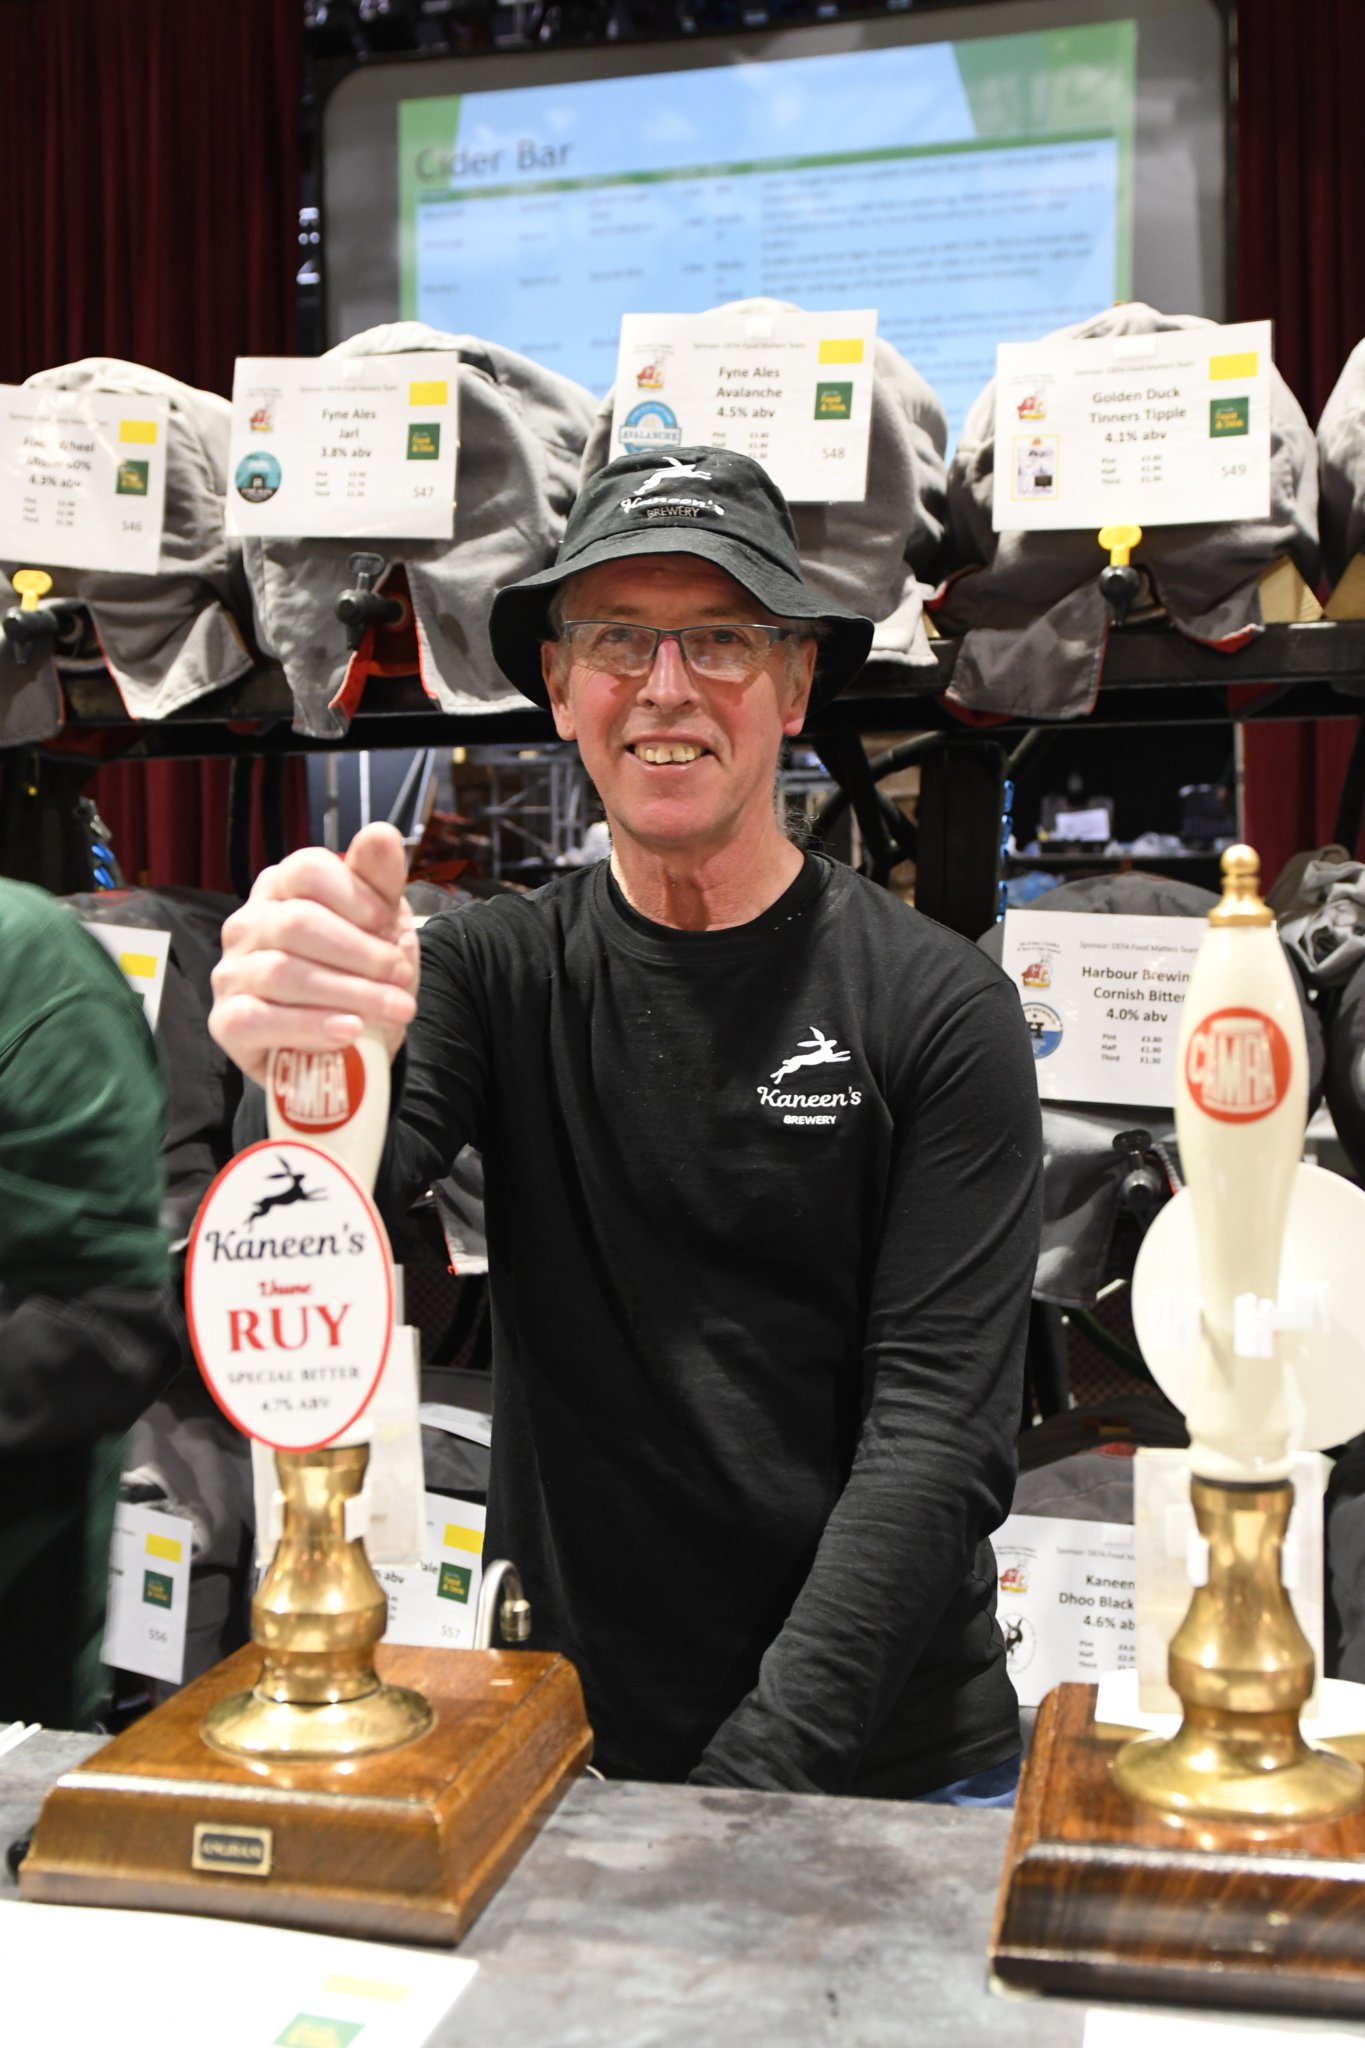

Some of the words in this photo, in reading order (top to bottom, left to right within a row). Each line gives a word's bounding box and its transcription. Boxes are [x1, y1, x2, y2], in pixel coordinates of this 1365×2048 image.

[415, 142, 502, 181] Cider
[516, 138, 572, 171] Bar
[719, 367, 749, 380] Fyne
[753, 366, 780, 378] Ales
[716, 386, 783, 398] Avalanche
[1092, 390, 1142, 404] Golden
[1146, 386, 1181, 400] Duck
[322, 408, 349, 421] Fyne
[352, 408, 377, 420] Ales
[717, 406, 748, 418] 4.5%
[752, 406, 775, 418] abv
[1089, 411, 1140, 423] Tinners
[1145, 406, 1187, 421] Tipple
[339, 427, 359, 439] Jarl
[1105, 431, 1137, 443] 4.1%
[1142, 429, 1167, 441] abv
[321, 446, 347, 458] 3.8%
[351, 446, 373, 458] abv
[646, 505, 700, 519] BREWERY
[1082, 966, 1138, 980] Harbour
[1142, 969, 1192, 984] Brewin
[1094, 987, 1144, 1001] Cornish
[1149, 990, 1186, 1003] Bitter
[1106, 1008, 1139, 1020] 4.0%
[1143, 1009, 1168, 1022] abv
[1188, 1030, 1276, 1108] CAMRA
[757, 1086, 862, 1108] Kaneen's
[783, 1115, 837, 1125] BREWERY
[205, 1222, 365, 1263] Kaneen's
[227, 1302, 352, 1353] RUY
[228, 1369, 294, 1384] SPECIAL
[301, 1366, 360, 1381] BITTER
[420, 1561, 438, 1576] ale
[384, 1570, 404, 1585] abv
[1059, 1591, 1095, 1606] Dhoo
[1099, 1596, 1134, 1610] Black
[1083, 1615, 1116, 1629] 4.6%
[1120, 1618, 1135, 1631] ab
